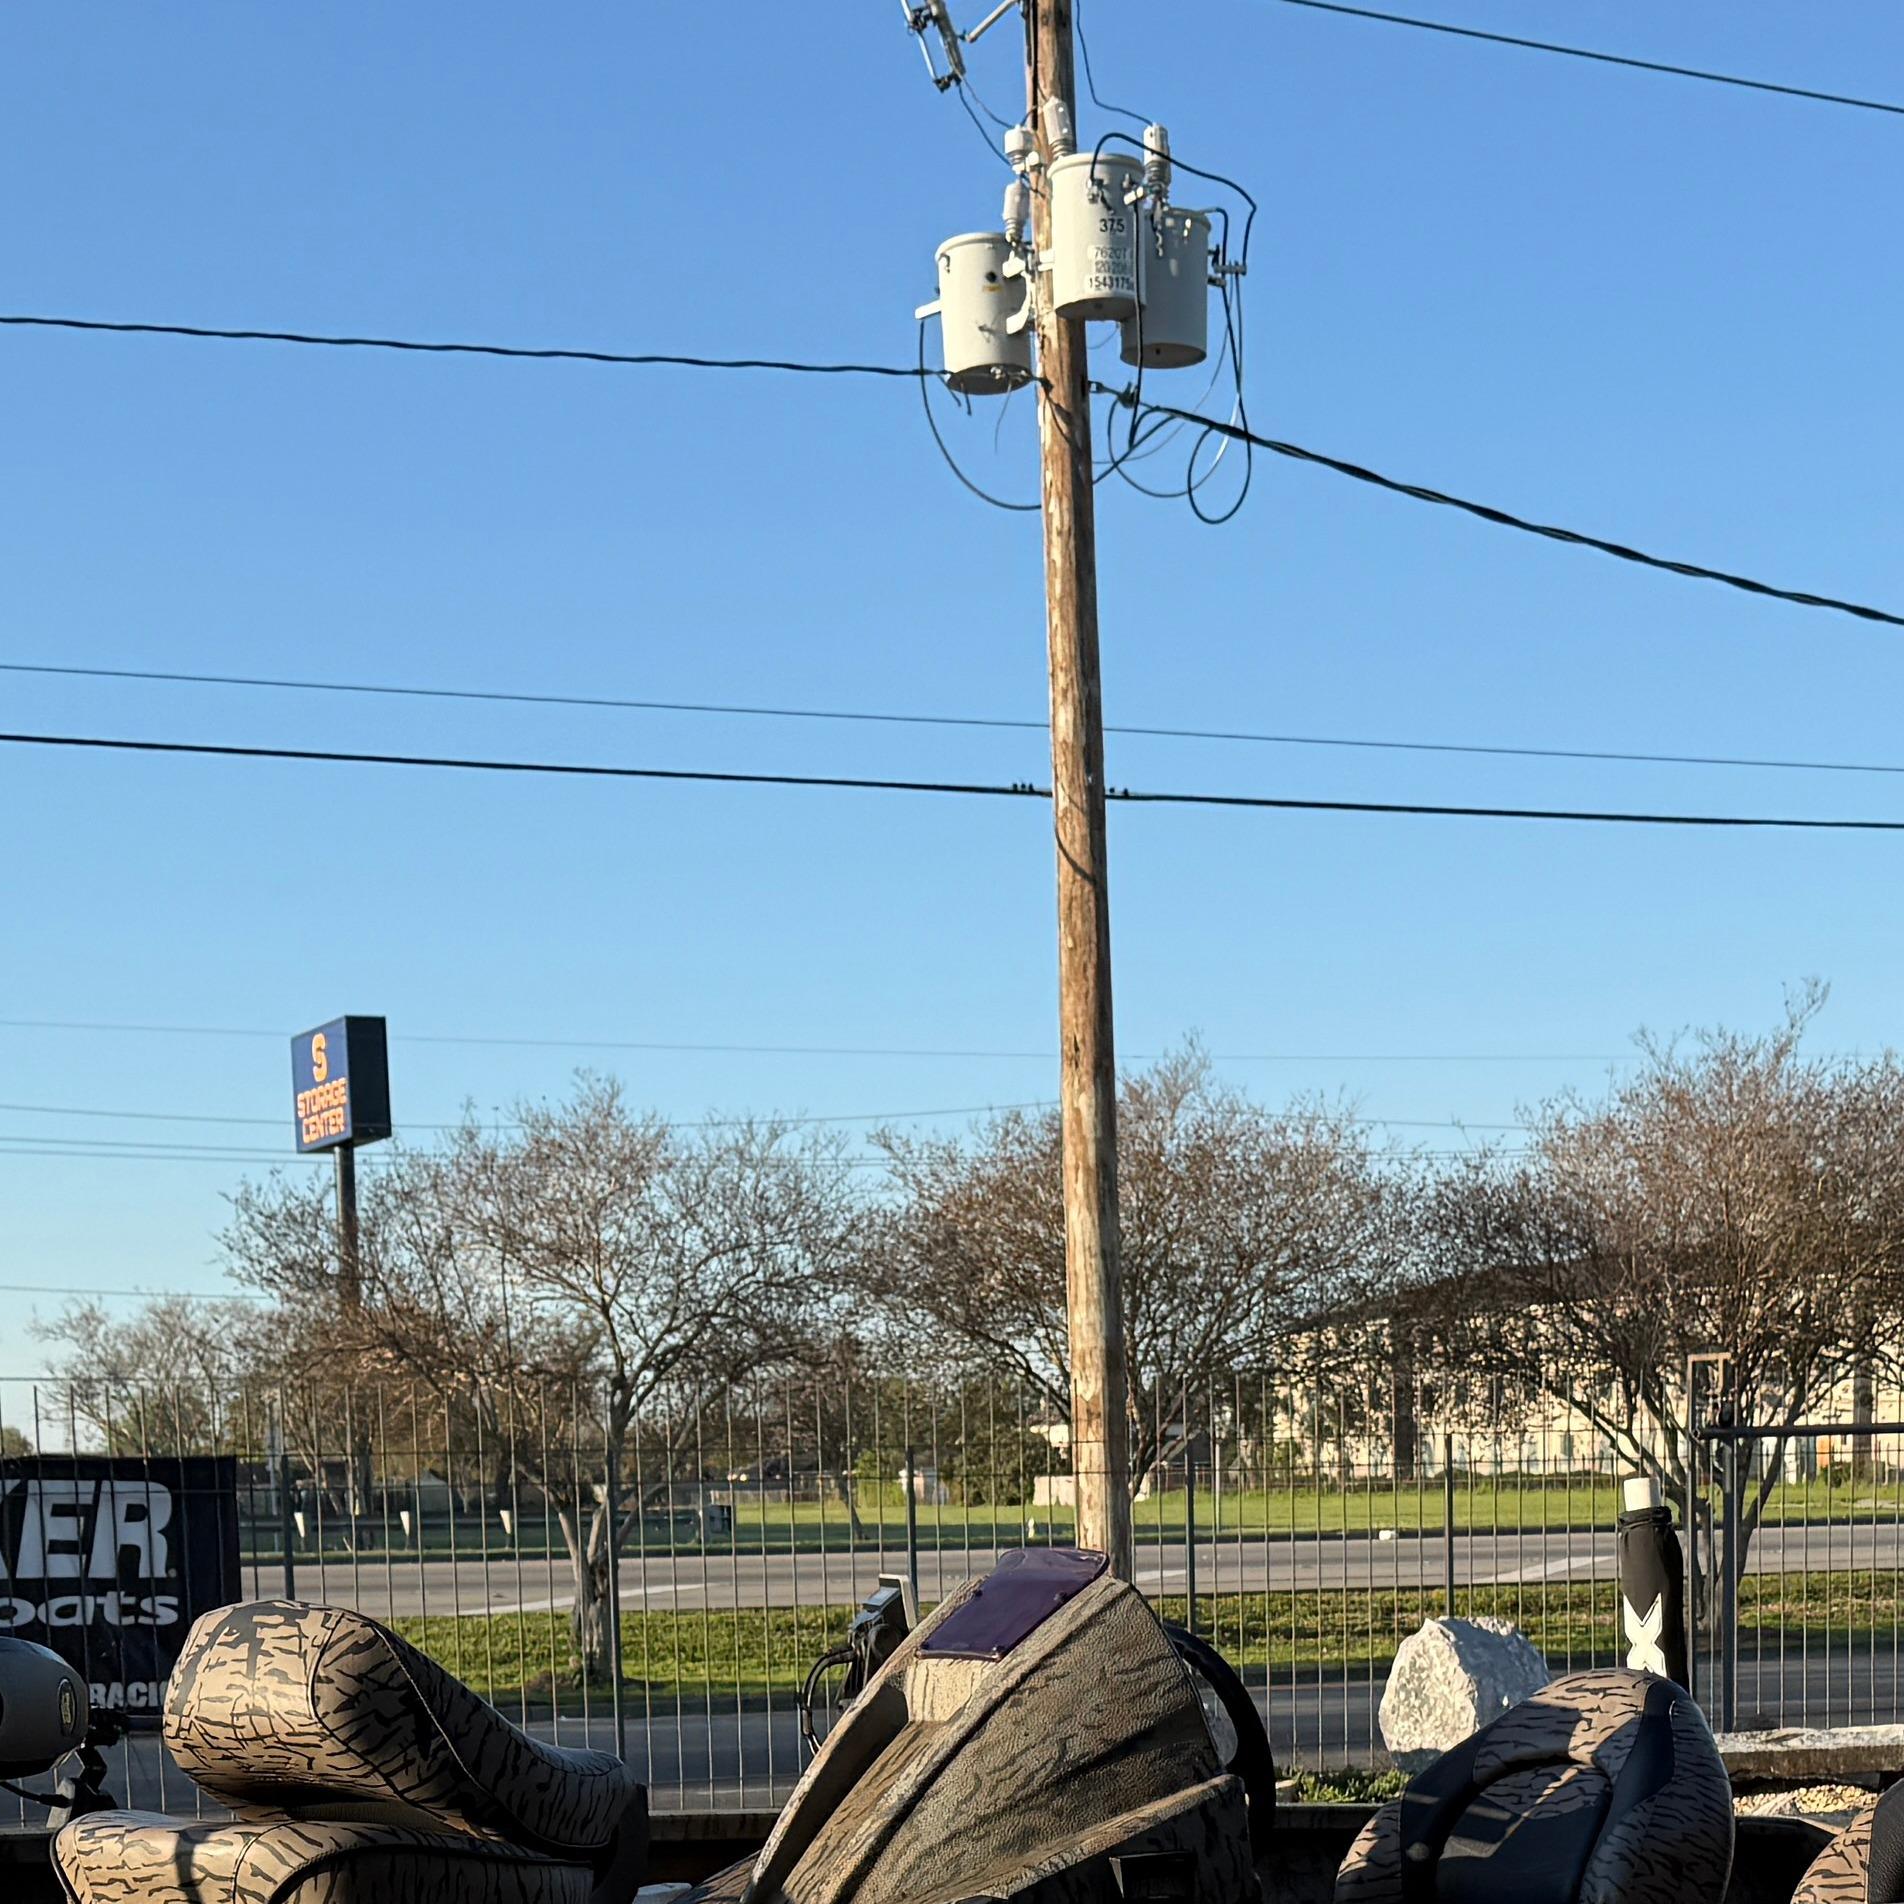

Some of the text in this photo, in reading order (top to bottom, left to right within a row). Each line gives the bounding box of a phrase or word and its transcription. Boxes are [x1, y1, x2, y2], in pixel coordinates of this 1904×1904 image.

[311, 1032, 328, 1083] S
[297, 1076, 347, 1119] STORAGE
[302, 1105, 345, 1145] CENTER
